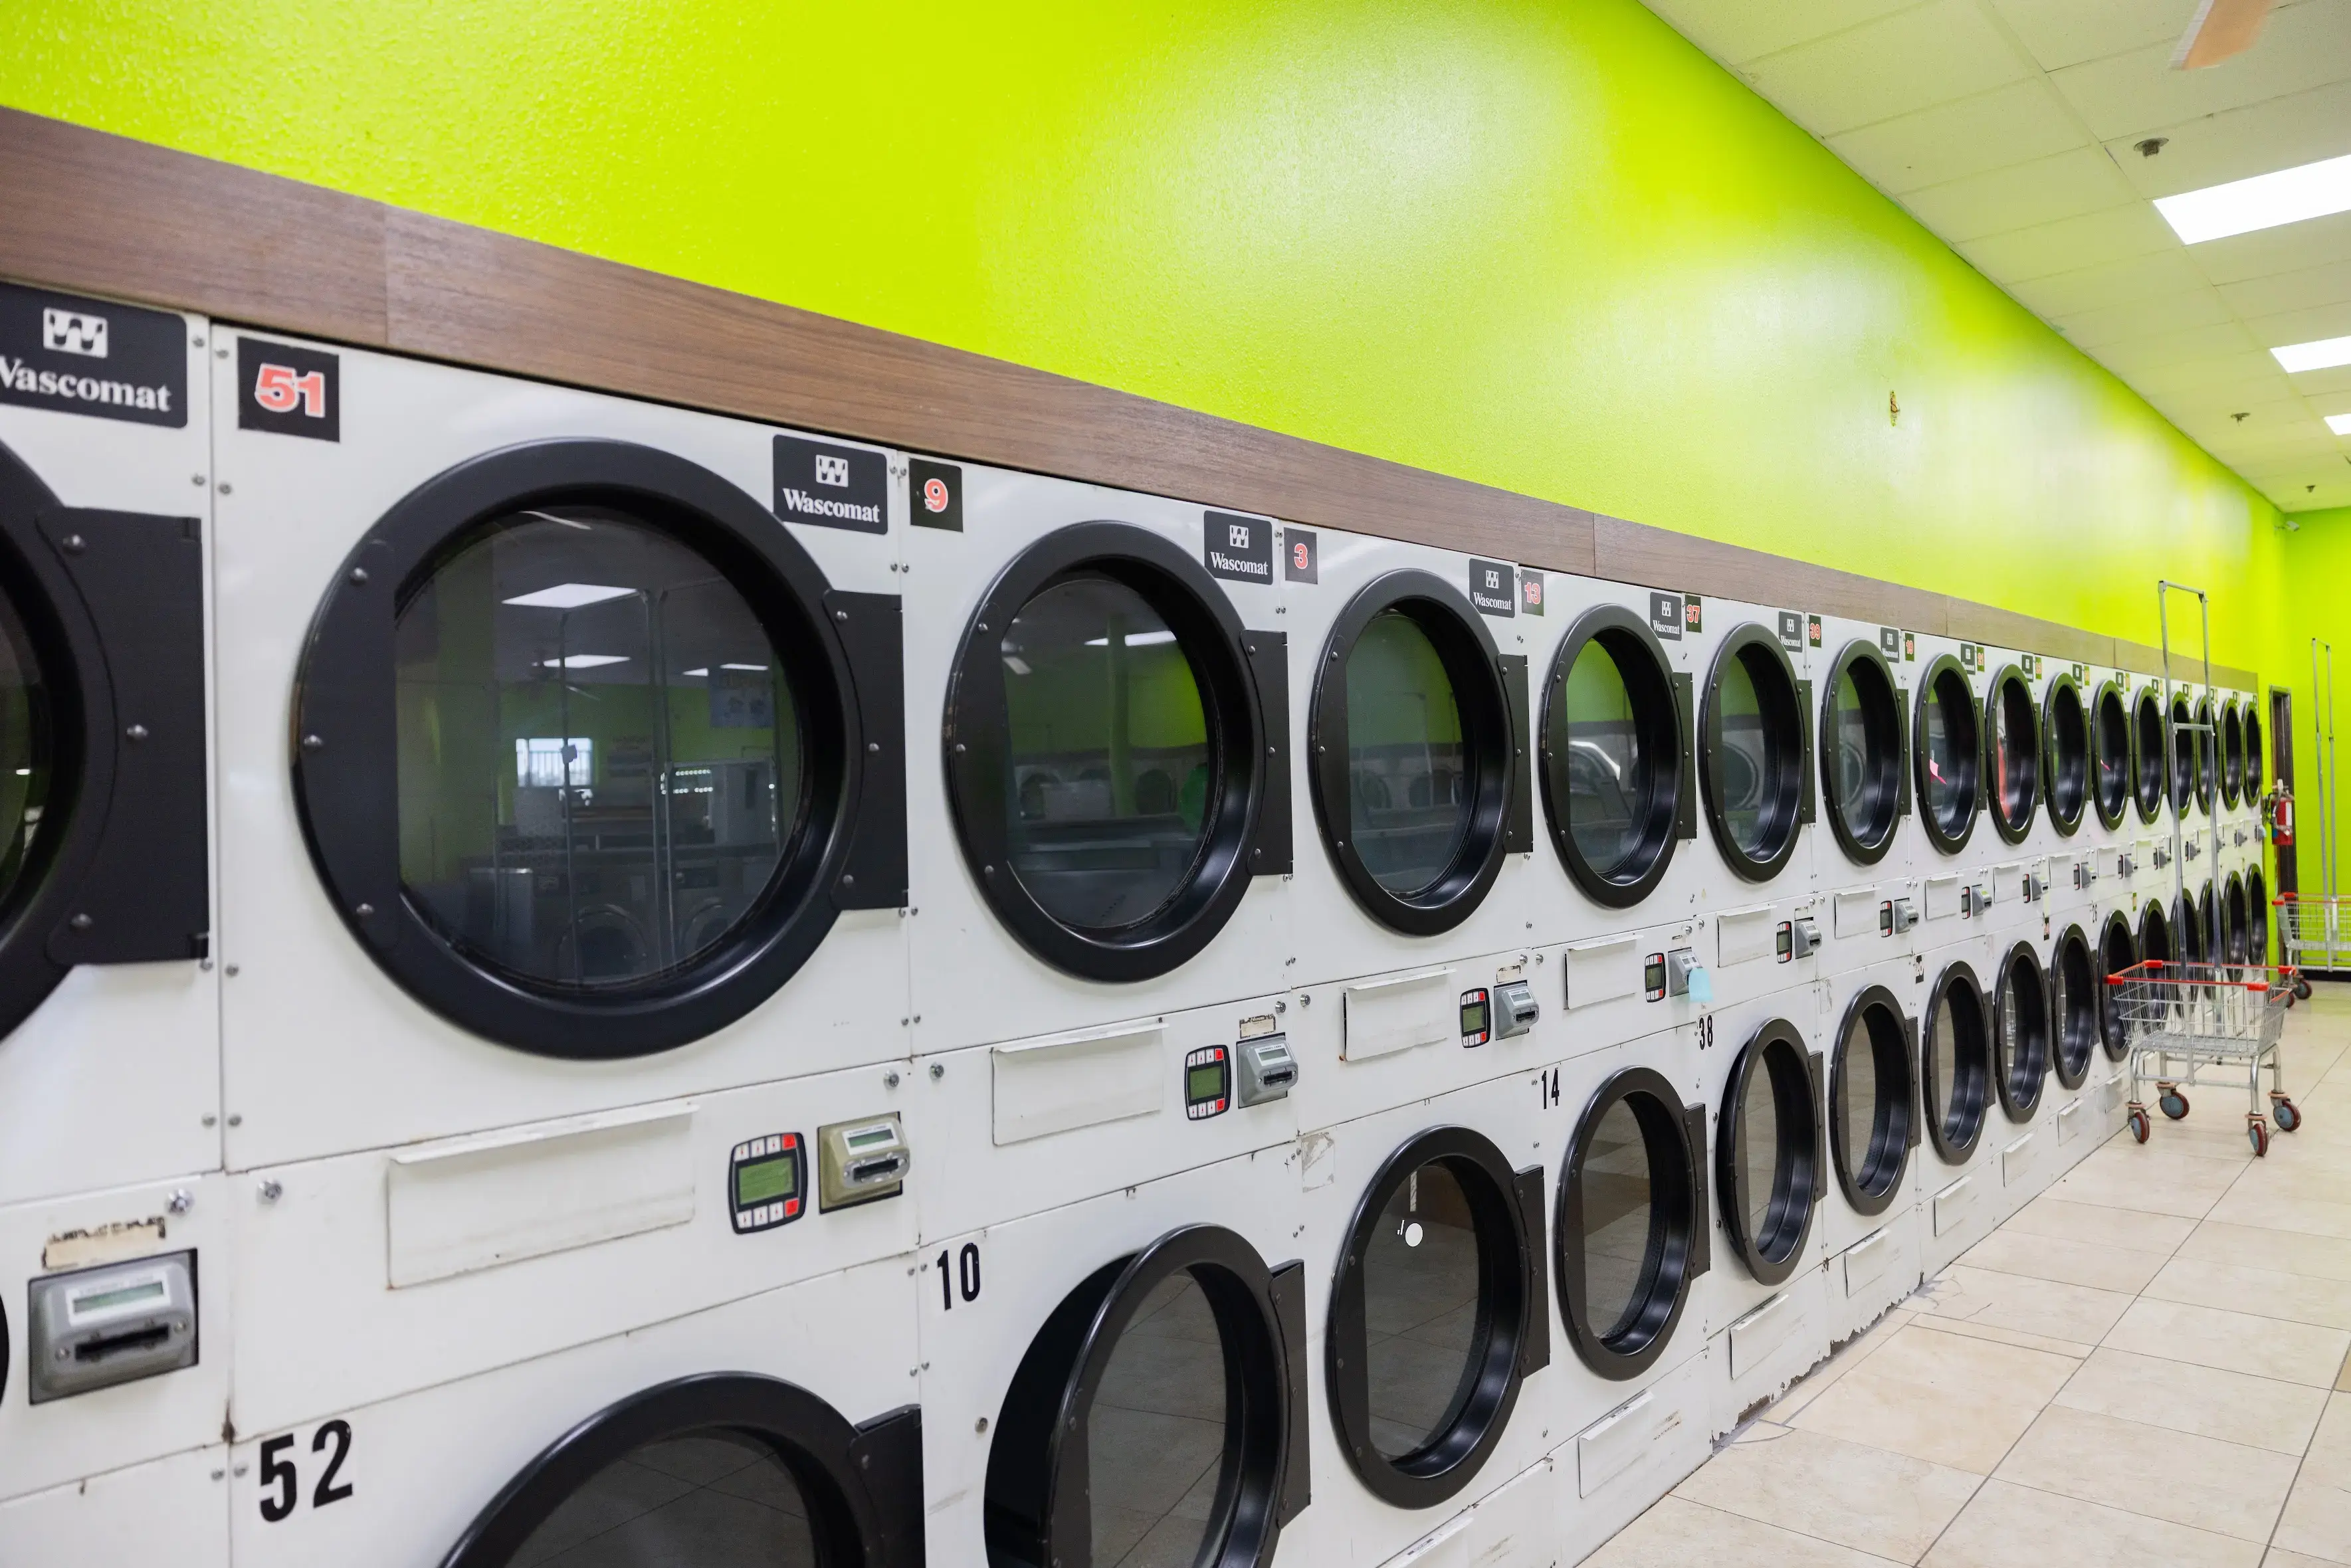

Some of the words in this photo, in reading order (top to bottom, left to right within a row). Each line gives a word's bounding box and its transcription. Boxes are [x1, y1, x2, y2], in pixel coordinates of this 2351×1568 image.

[254, 362, 326, 419] 51
[782, 488, 880, 524] Wascomat
[924, 478, 949, 513] 9
[1210, 551, 1269, 576] Wascomat
[1294, 543, 1308, 569] 3
[1473, 591, 1512, 611] Wascomat
[1524, 581, 1542, 605] 13
[1653, 619, 1681, 635] Wascomat
[1687, 604, 1700, 624] 37
[1809, 623, 1821, 640] 39
[1698, 1015, 1713, 1050] 38
[1541, 1067, 1560, 1110] 14
[936, 1242, 981, 1312] 10
[259, 1419, 354, 1524] 52
